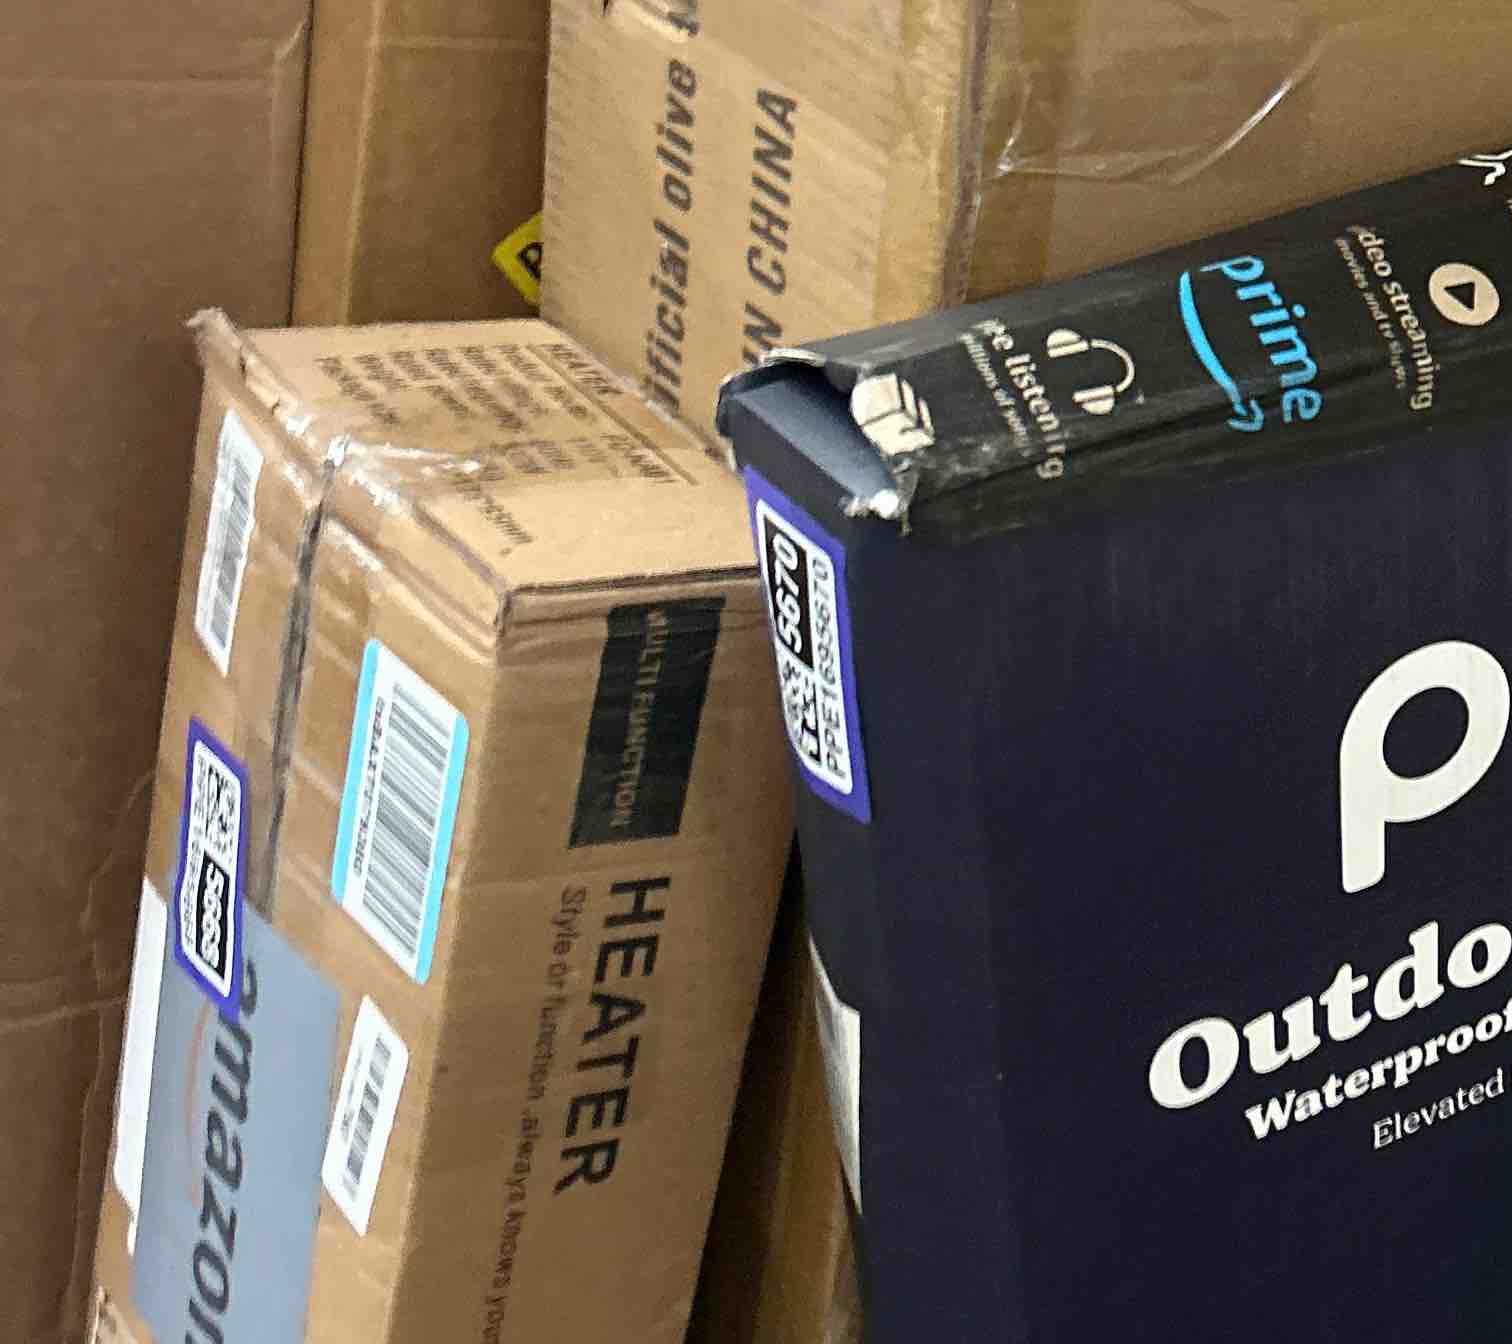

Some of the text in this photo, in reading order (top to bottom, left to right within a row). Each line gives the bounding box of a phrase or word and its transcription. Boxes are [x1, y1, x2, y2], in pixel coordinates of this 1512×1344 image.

[656, 58, 697, 213] olive
[747, 87, 798, 297] CHINA
[1200, 255, 1323, 424] prime
[1382, 281, 1440, 411] streaming
[771, 531, 803, 656] 5670
[551, 883, 587, 957] Style
[552, 876, 672, 1196] HEATER
[1373, 1066, 1505, 1150] Elevated
